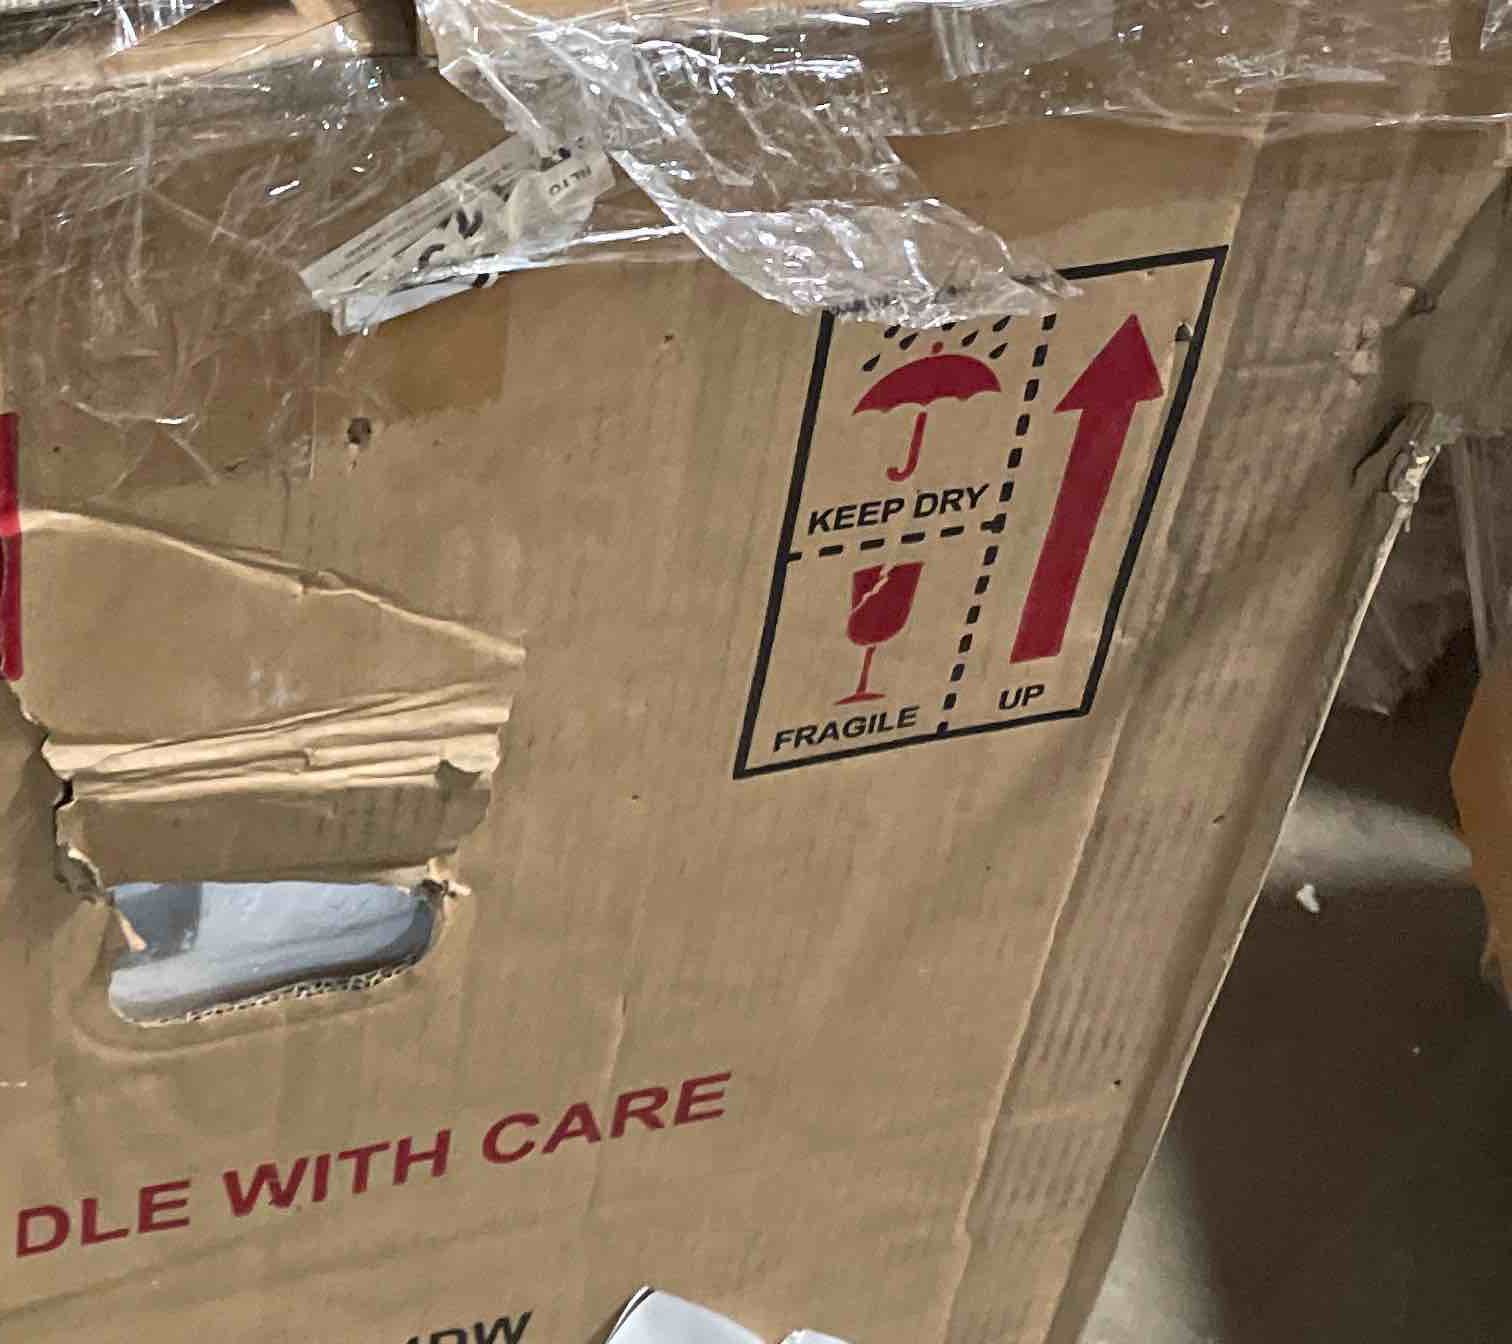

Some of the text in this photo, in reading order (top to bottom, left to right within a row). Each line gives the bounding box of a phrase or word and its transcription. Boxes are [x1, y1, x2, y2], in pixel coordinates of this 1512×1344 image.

[806, 483, 990, 536] KEEP DRY
[997, 684, 1046, 711] UP
[773, 706, 920, 753] FRAGILE
[16, 1072, 732, 1257] DLE WITH CARE
